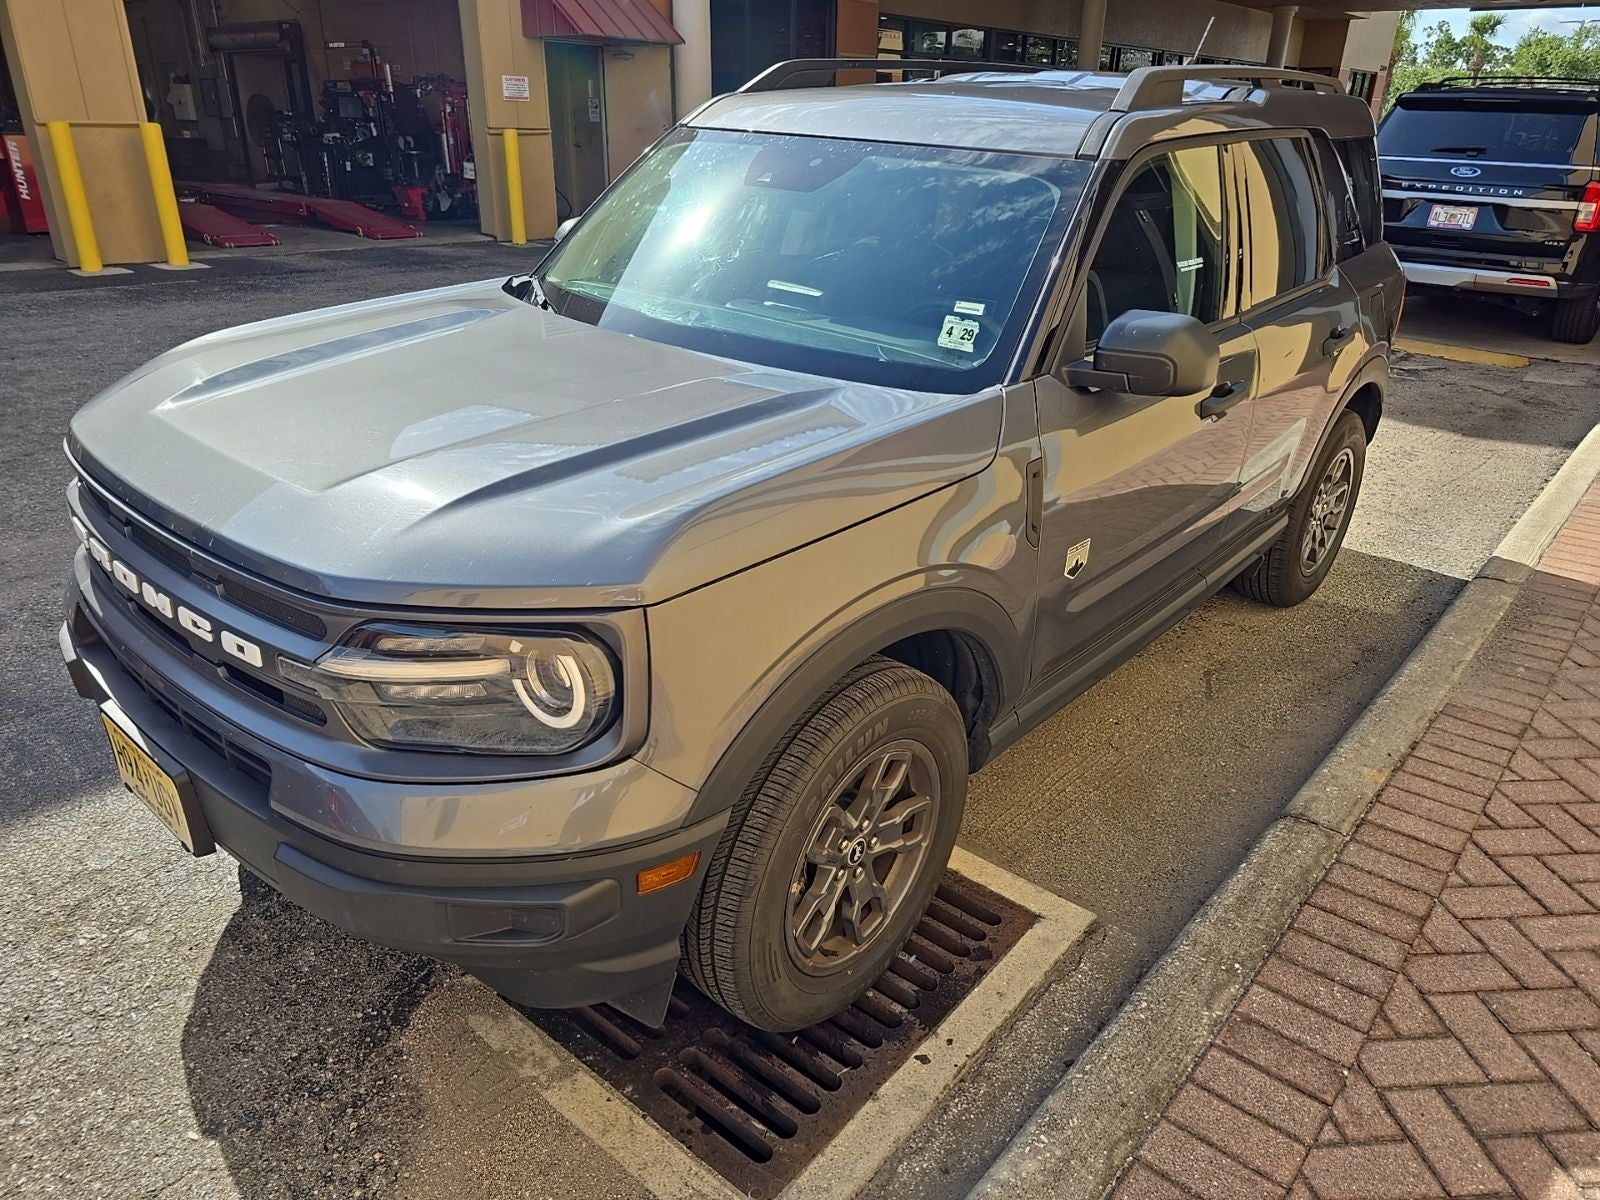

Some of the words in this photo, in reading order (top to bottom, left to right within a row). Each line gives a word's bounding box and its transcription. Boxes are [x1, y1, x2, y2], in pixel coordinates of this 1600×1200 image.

[7, 140, 32, 200] HUNTER
[1401, 182, 1524, 196] EXPEDITION
[946, 325, 954, 338] 4
[959, 327, 975, 341] 29
